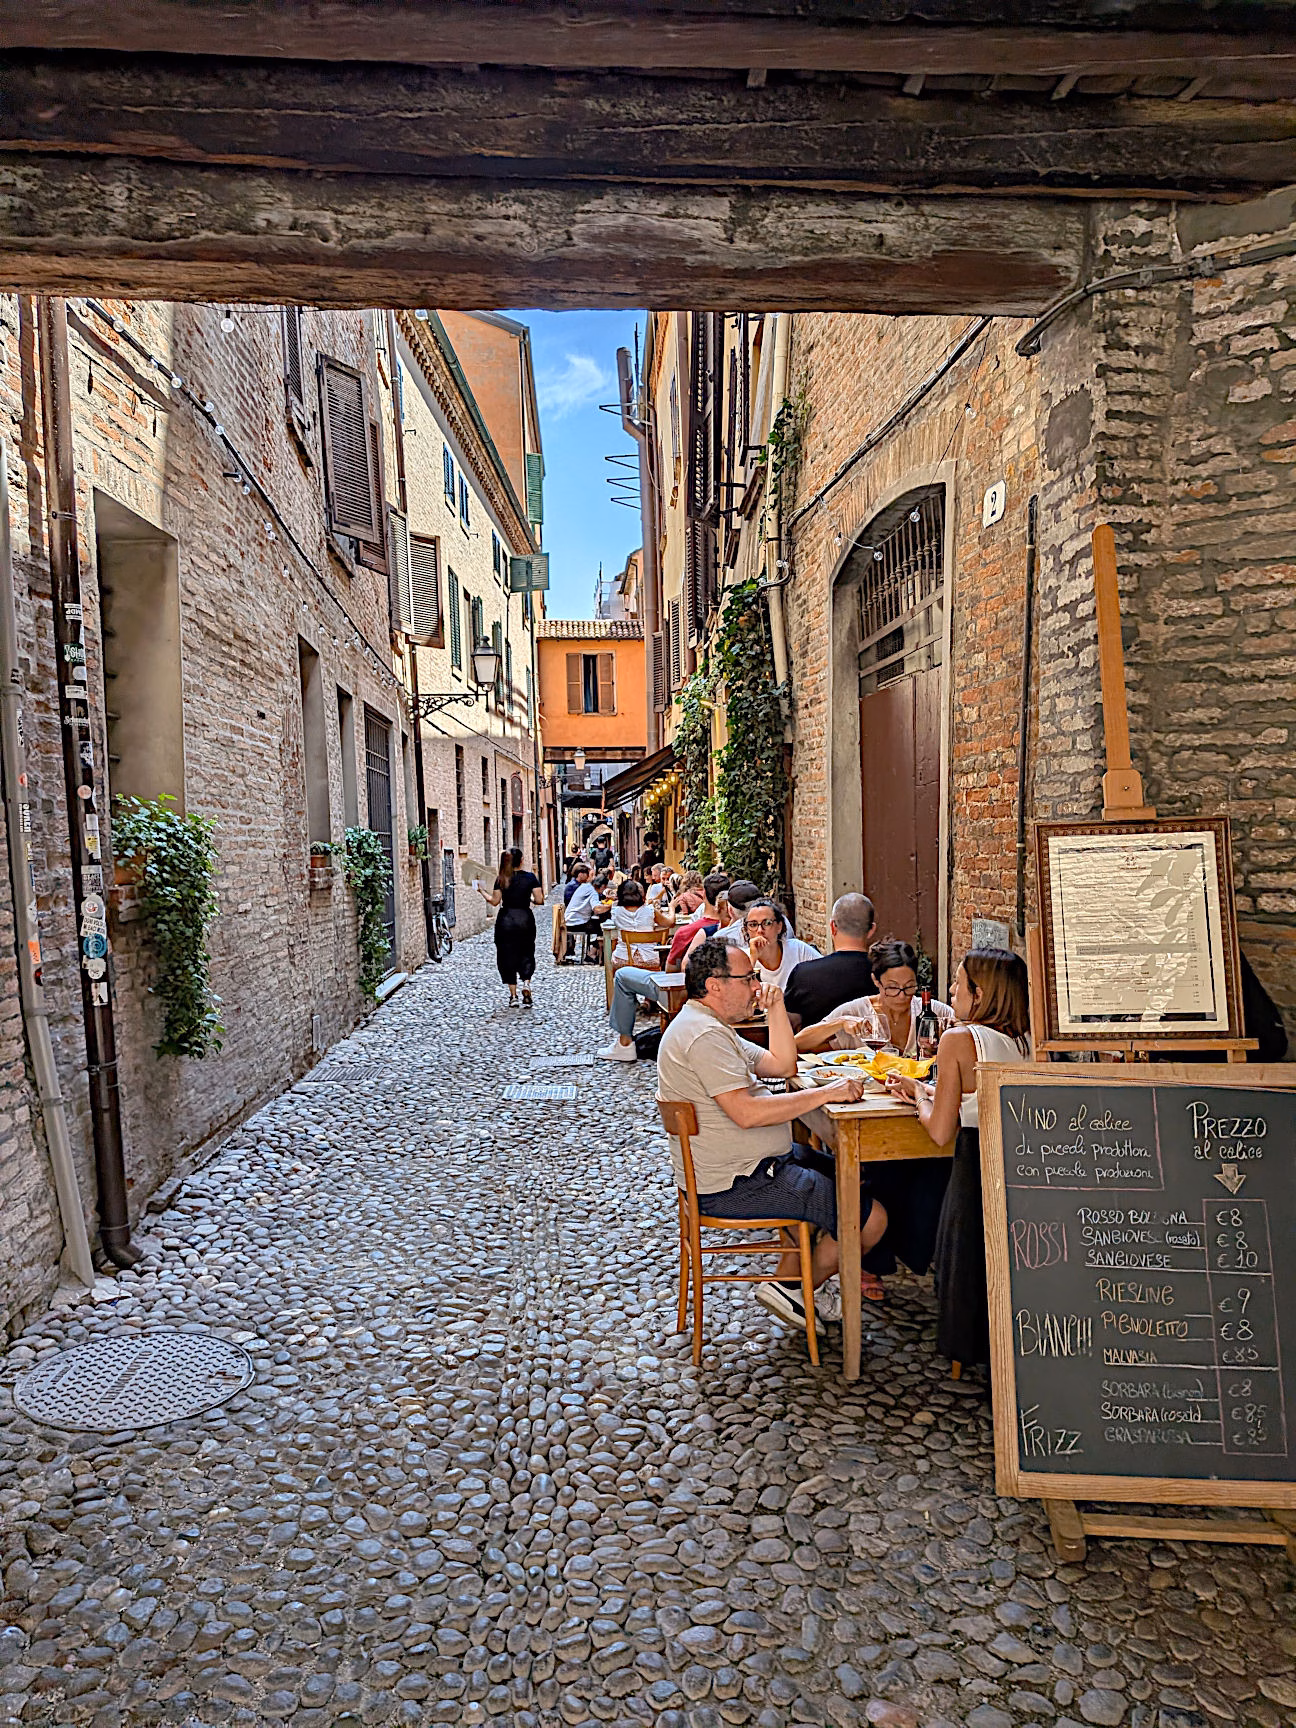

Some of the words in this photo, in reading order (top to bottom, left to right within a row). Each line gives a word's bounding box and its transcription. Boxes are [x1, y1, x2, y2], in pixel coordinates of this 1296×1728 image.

[1008, 1093, 1058, 1131] VINO
[1068, 1104, 1086, 1131] al
[1089, 1109, 1133, 1132] calice
[1186, 1101, 1268, 1140] PREZZO
[1015, 1133, 1034, 1155] di
[1040, 1134, 1087, 1163] piccoli
[1193, 1141, 1211, 1160] al
[1219, 1141, 1264, 1160] calice
[1017, 1164, 1040, 1178] con
[1045, 1160, 1088, 1184] piccole
[1077, 1207, 1125, 1226] ROSSO
[1010, 1218, 1069, 1271] ROSSI
[1084, 1250, 1172, 1269] SANGIOVESE
[1096, 1277, 1175, 1306] RIESLING
[1101, 1312, 1188, 1338] PIGNOLETTO
[1103, 1348, 1158, 1364] MALVASIA
[1101, 1378, 1160, 1399] SORBARA
[1101, 1401, 1160, 1423] SORBARA
[1020, 1404, 1084, 1457] FRIZZ
